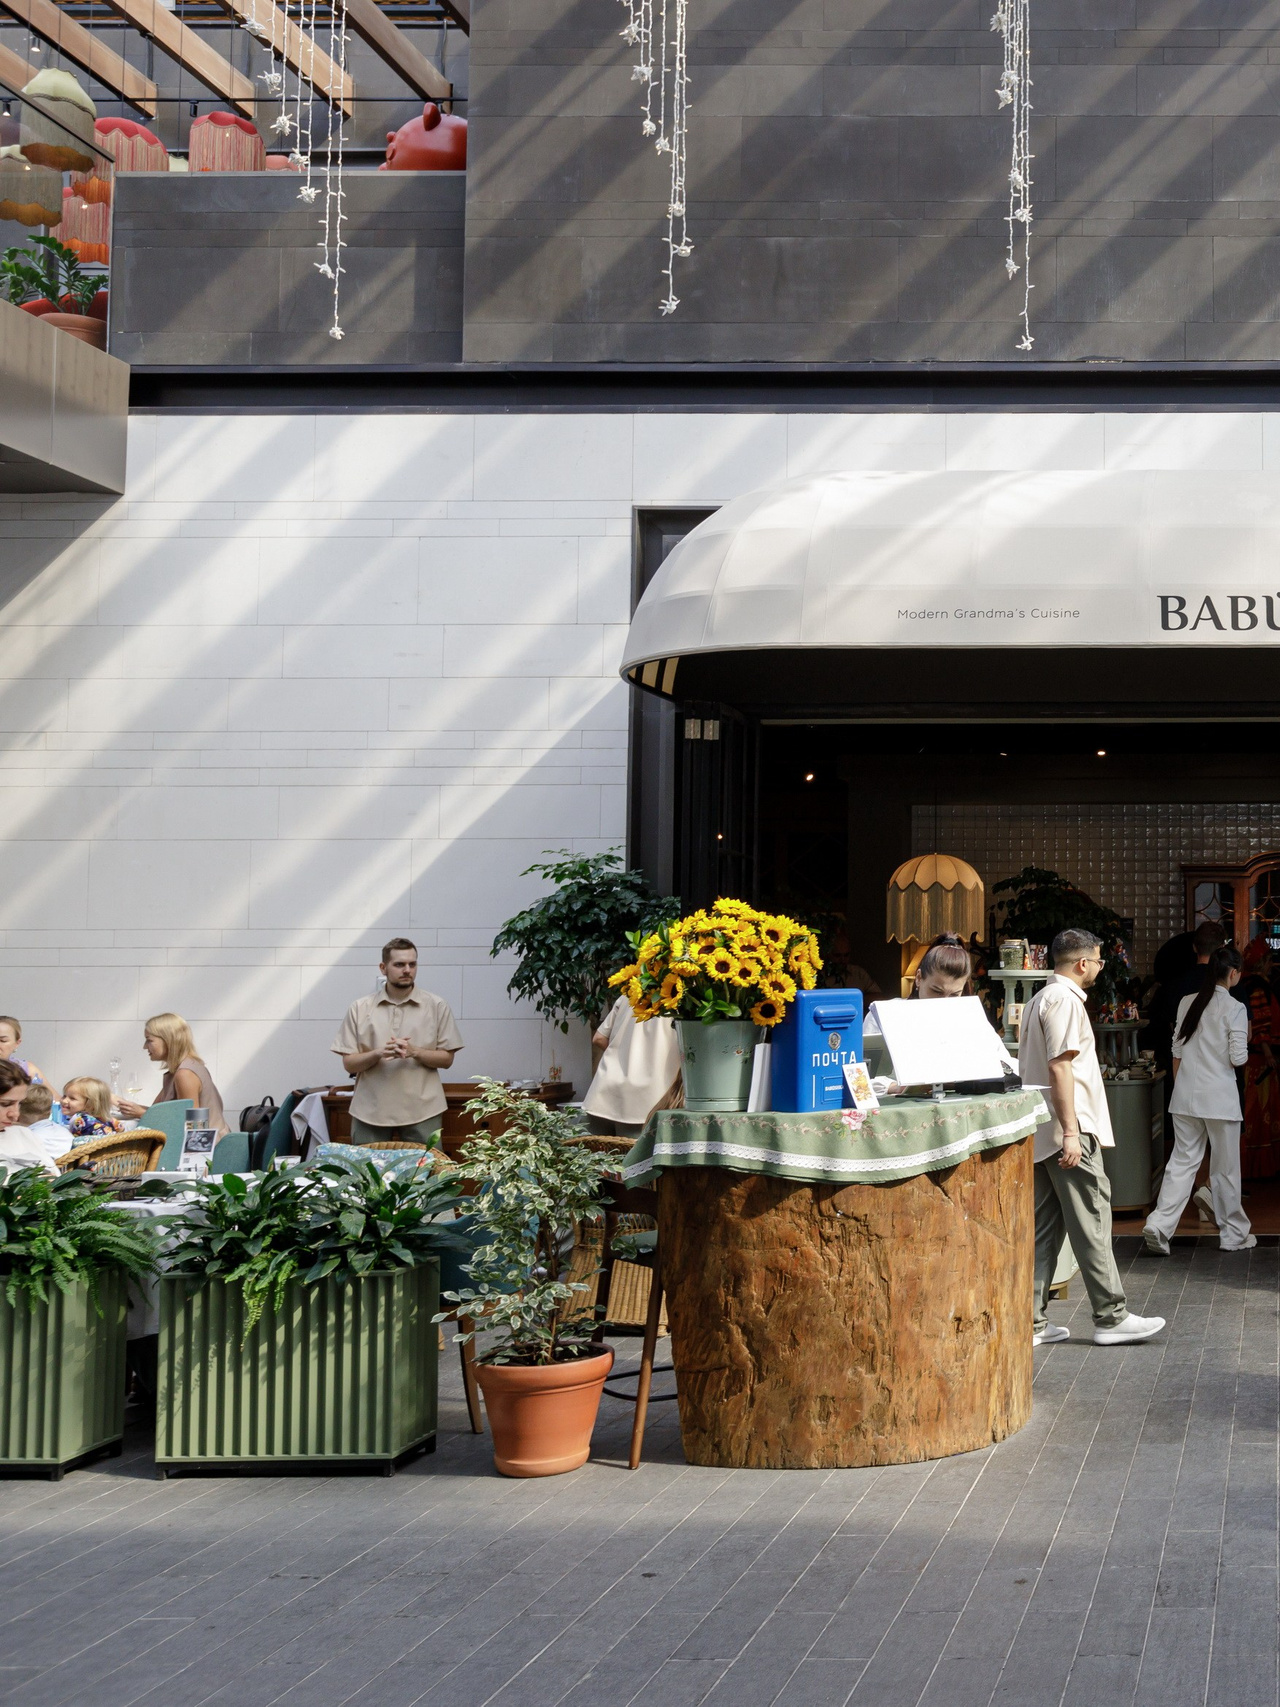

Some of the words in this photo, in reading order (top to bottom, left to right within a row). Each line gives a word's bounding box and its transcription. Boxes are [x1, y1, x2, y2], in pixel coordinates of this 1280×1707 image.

[897, 609, 949, 619] Modern
[953, 608, 1026, 619] Grandma's
[1030, 608, 1081, 619] Cuisine
[812, 1051, 857, 1067] ПОЧТА
